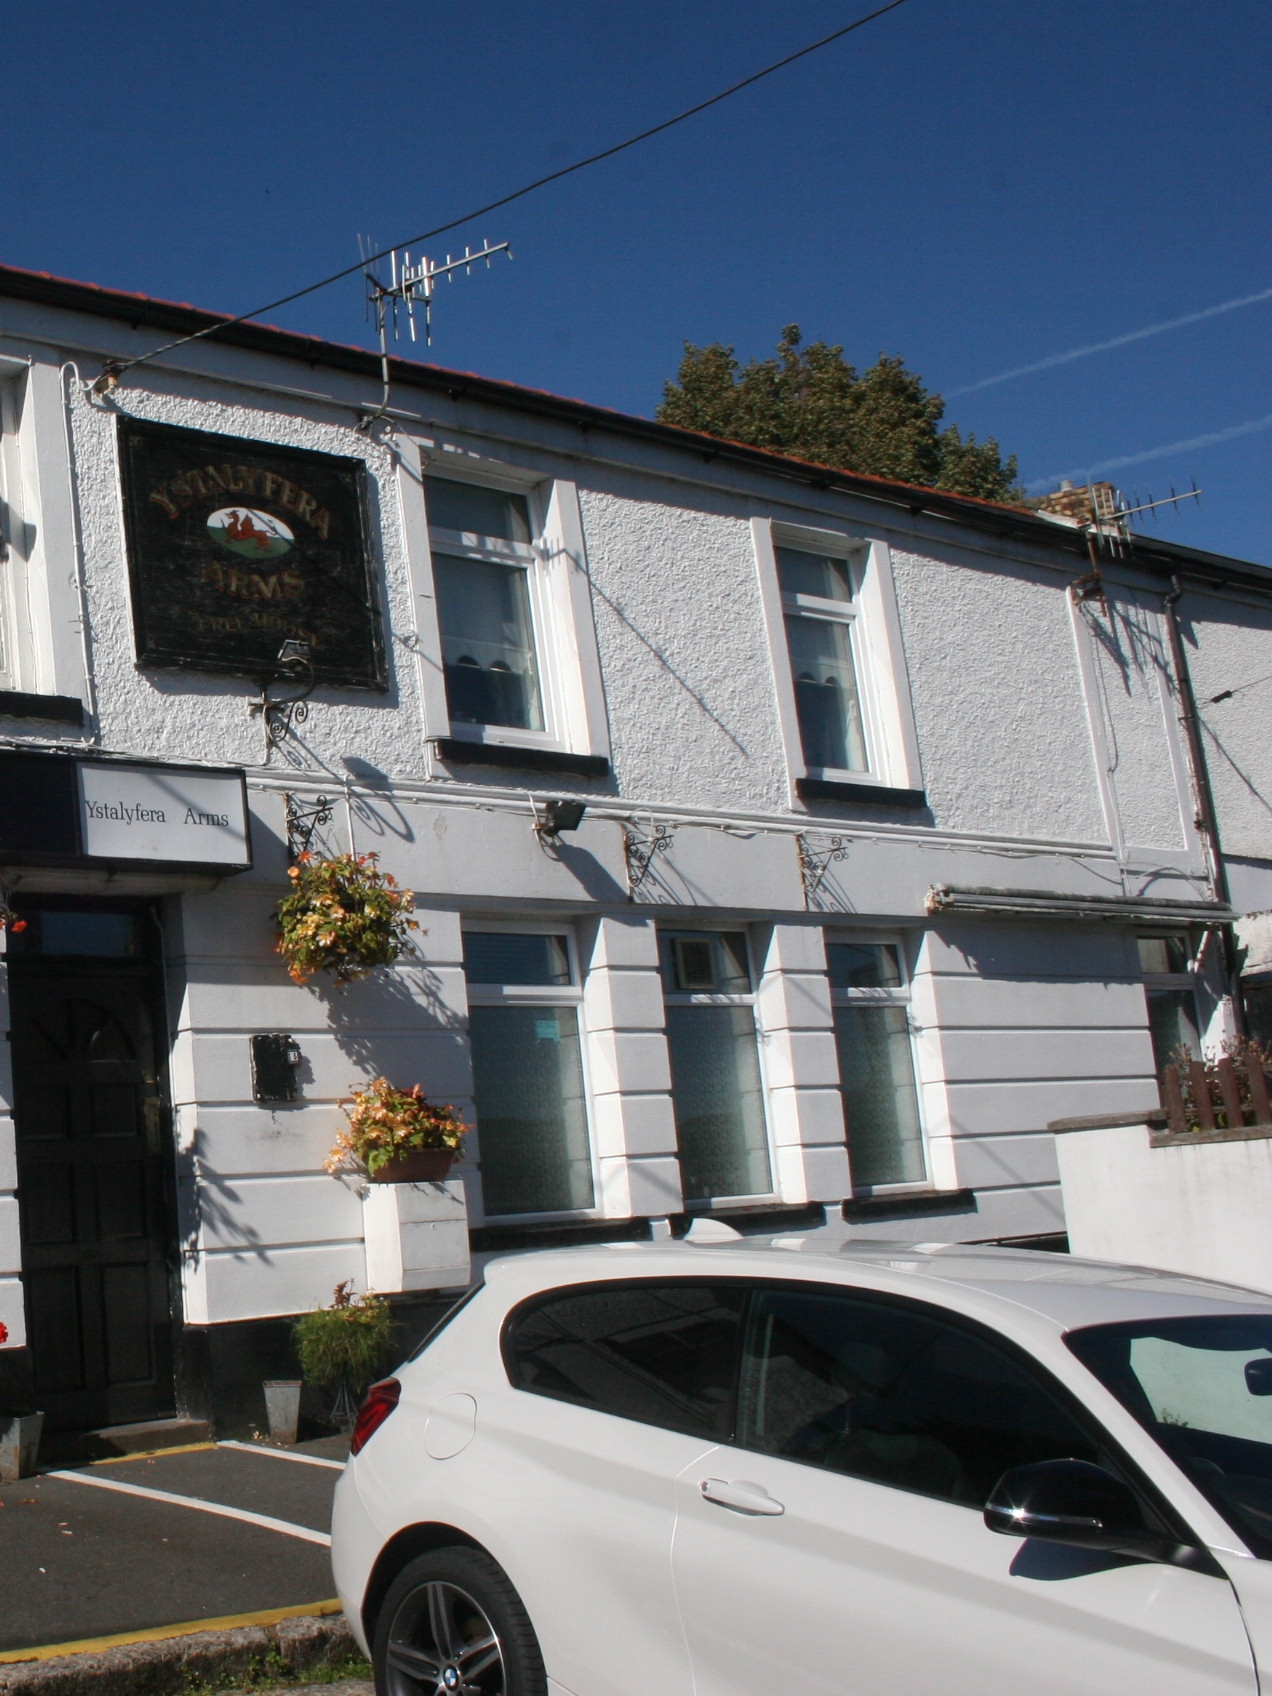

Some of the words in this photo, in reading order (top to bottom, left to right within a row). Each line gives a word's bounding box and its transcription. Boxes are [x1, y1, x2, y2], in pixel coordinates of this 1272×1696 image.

[149, 464, 330, 541] YSTALYFERA
[200, 560, 305, 601] ARMS
[85, 800, 166, 825] Ystalyfera
[183, 807, 229, 827] Arms
